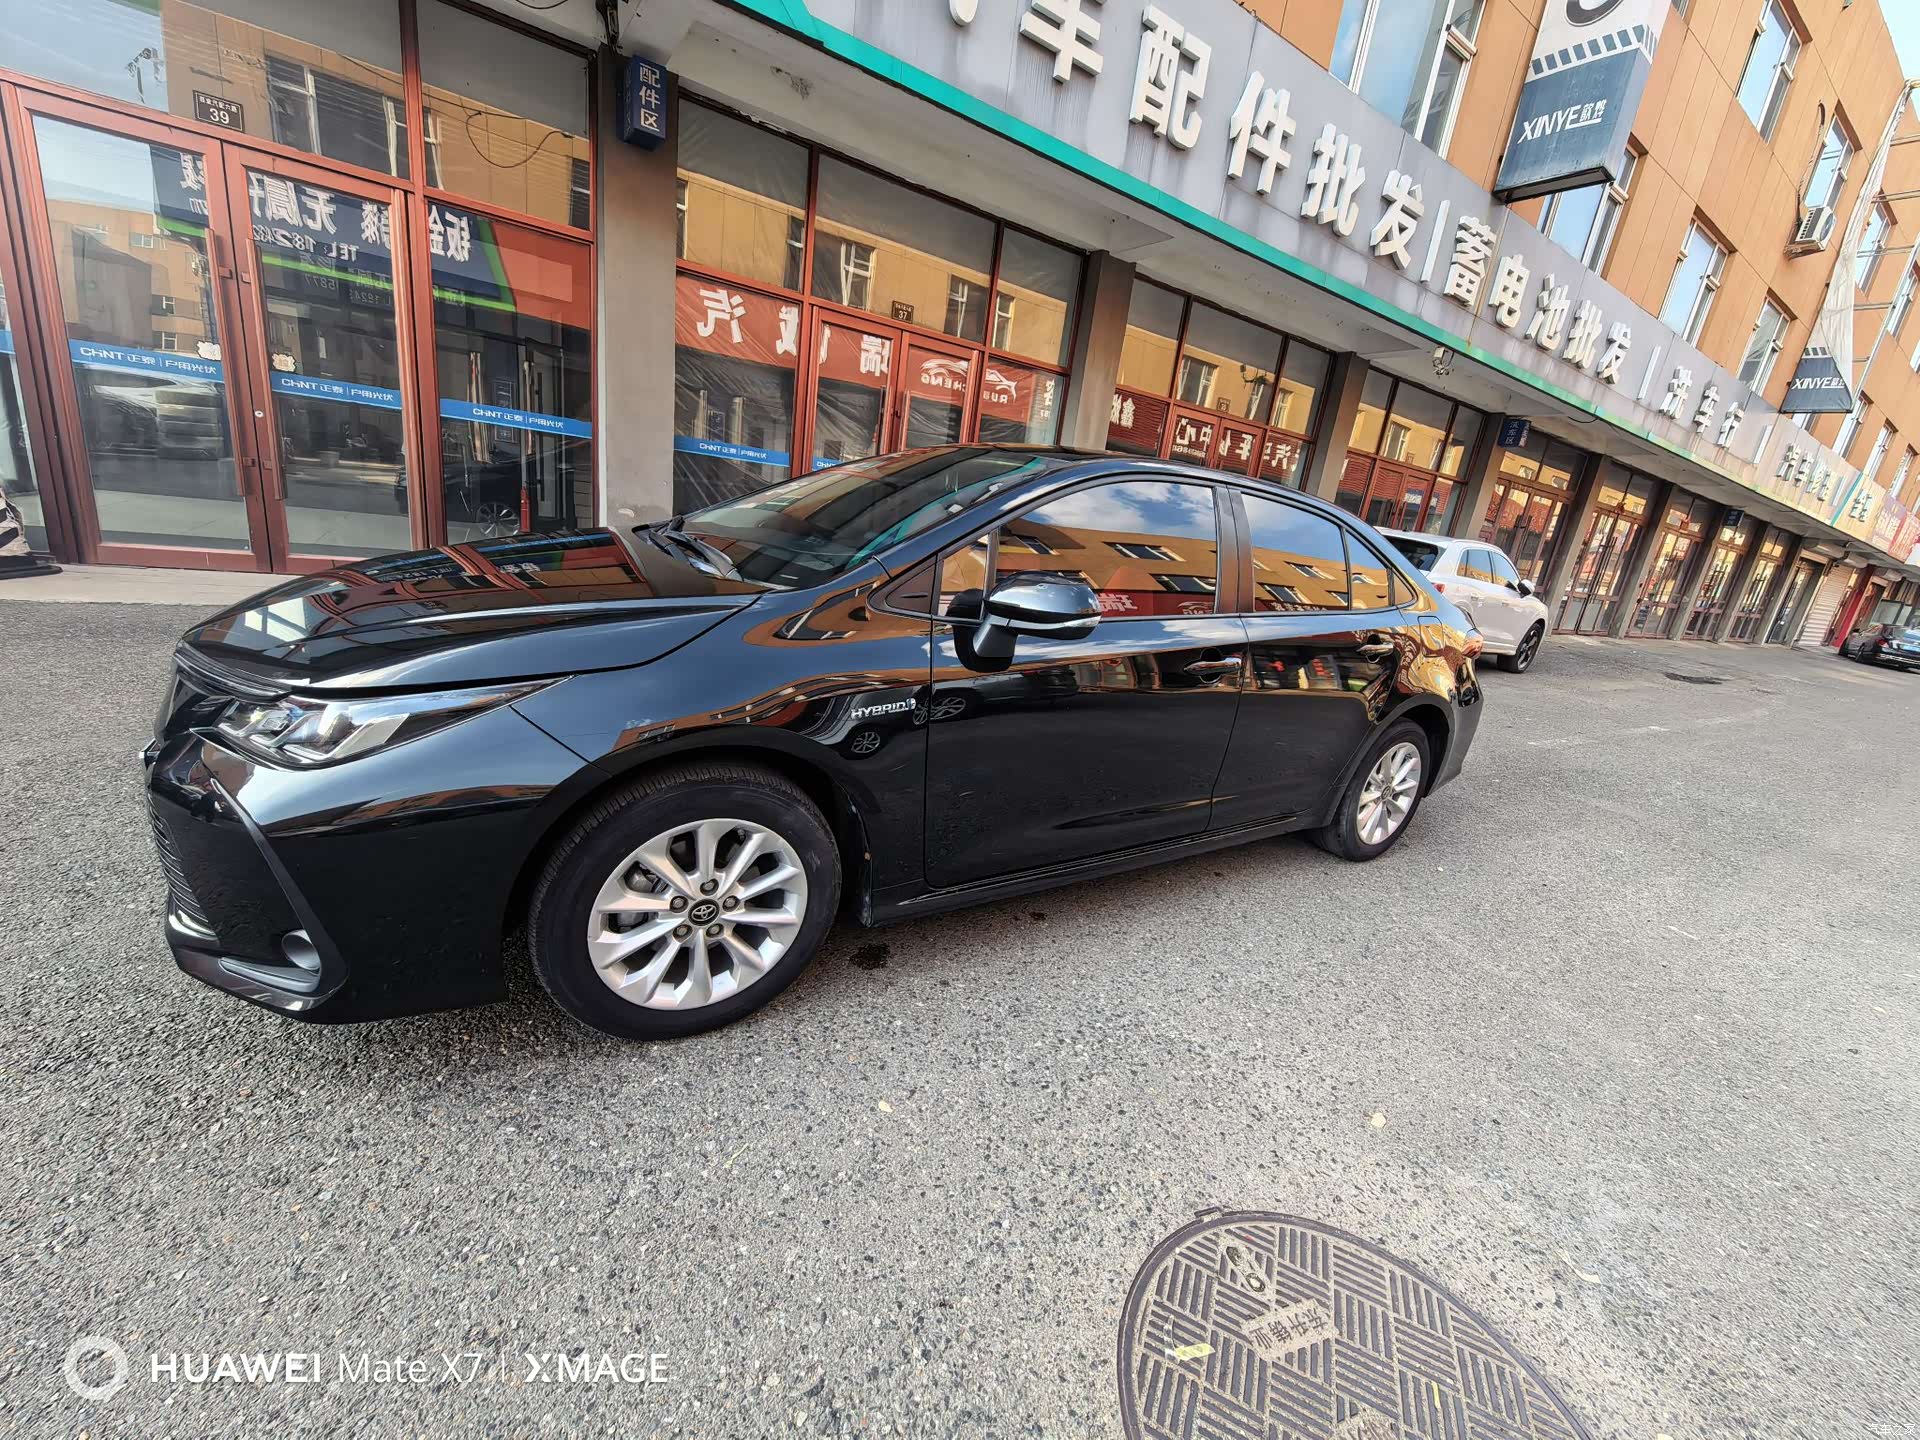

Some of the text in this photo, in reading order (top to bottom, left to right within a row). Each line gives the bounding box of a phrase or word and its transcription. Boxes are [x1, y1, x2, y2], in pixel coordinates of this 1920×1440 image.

[639, 62, 661, 132] 配件区
[209, 108, 230, 124] 39
[1517, 104, 1584, 144] XINYE
[949, 0, 1425, 270] 车配件批发
[1443, 215, 1632, 385] 蓄电池批发
[1658, 365, 1744, 449] 洗车行
[898, 311, 908, 320] 37
[1791, 377, 1833, 390] XINYE
[850, 701, 909, 720] HYBRID
